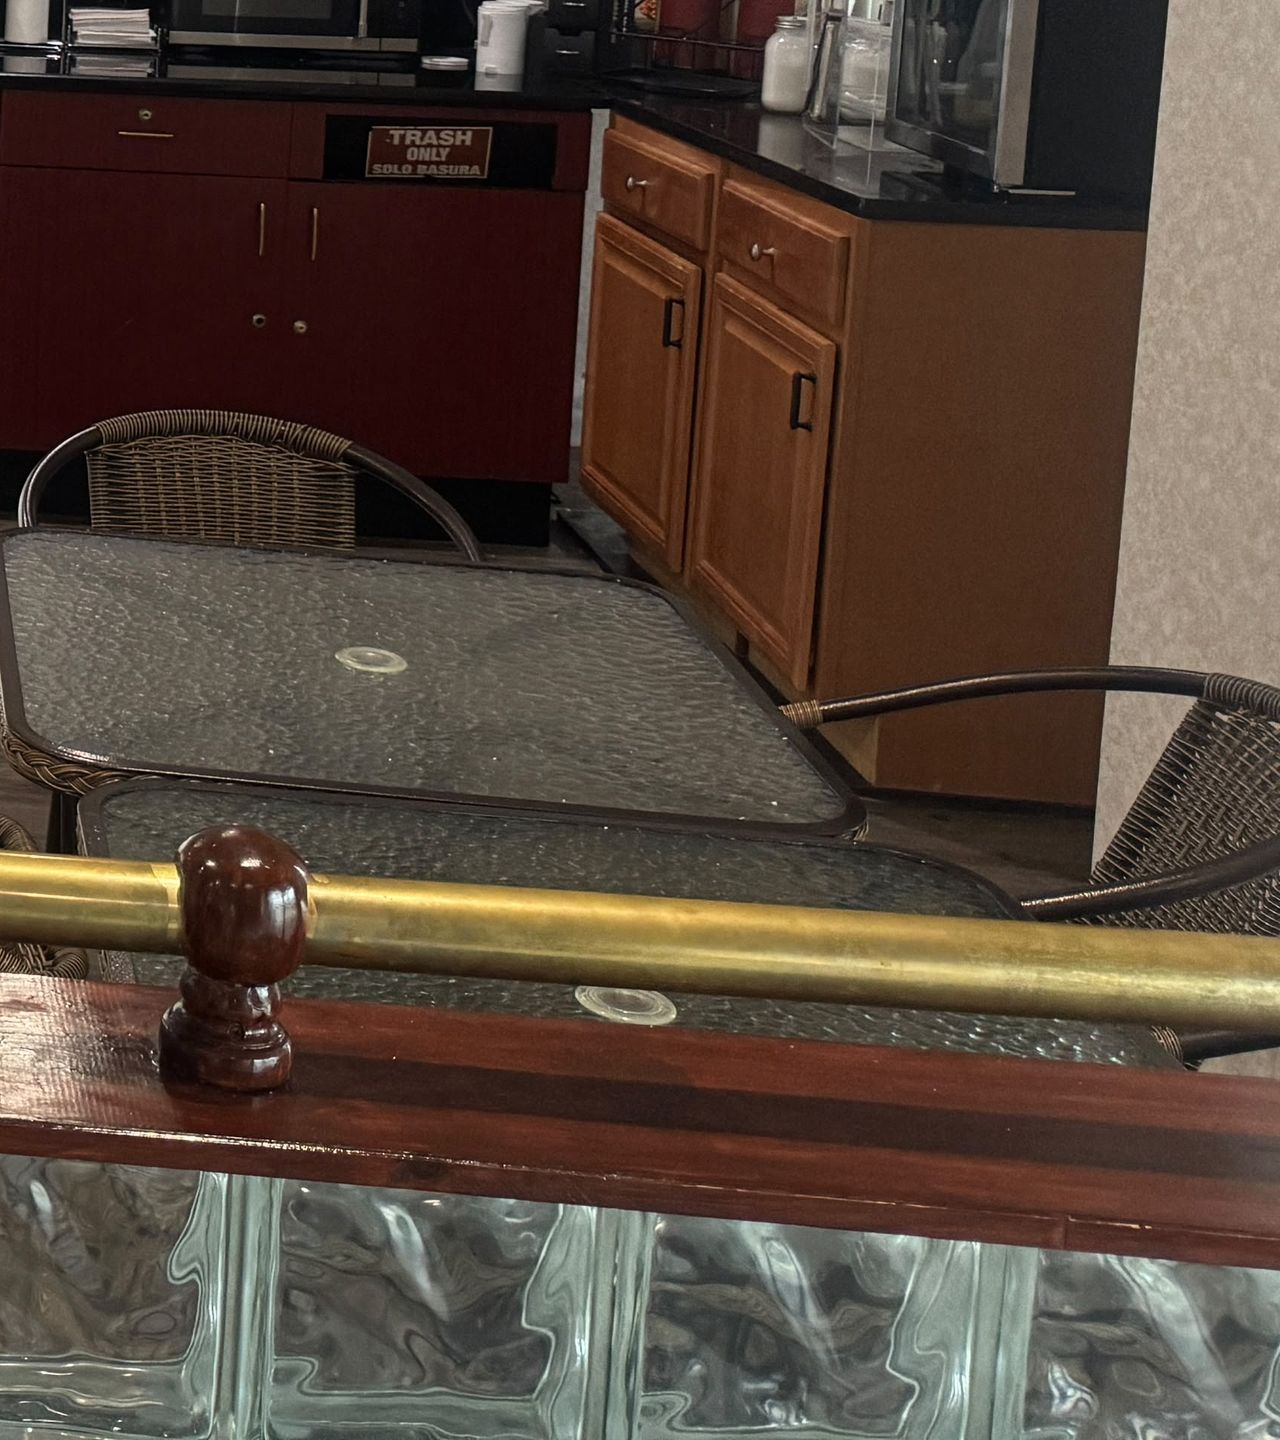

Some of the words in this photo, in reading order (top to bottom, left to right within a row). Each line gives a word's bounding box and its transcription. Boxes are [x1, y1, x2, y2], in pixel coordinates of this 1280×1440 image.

[389, 130, 472, 146] TRASH
[406, 147, 451, 162] ONLY
[372, 164, 412, 174] SOLO
[417, 165, 481, 175] BASURA
